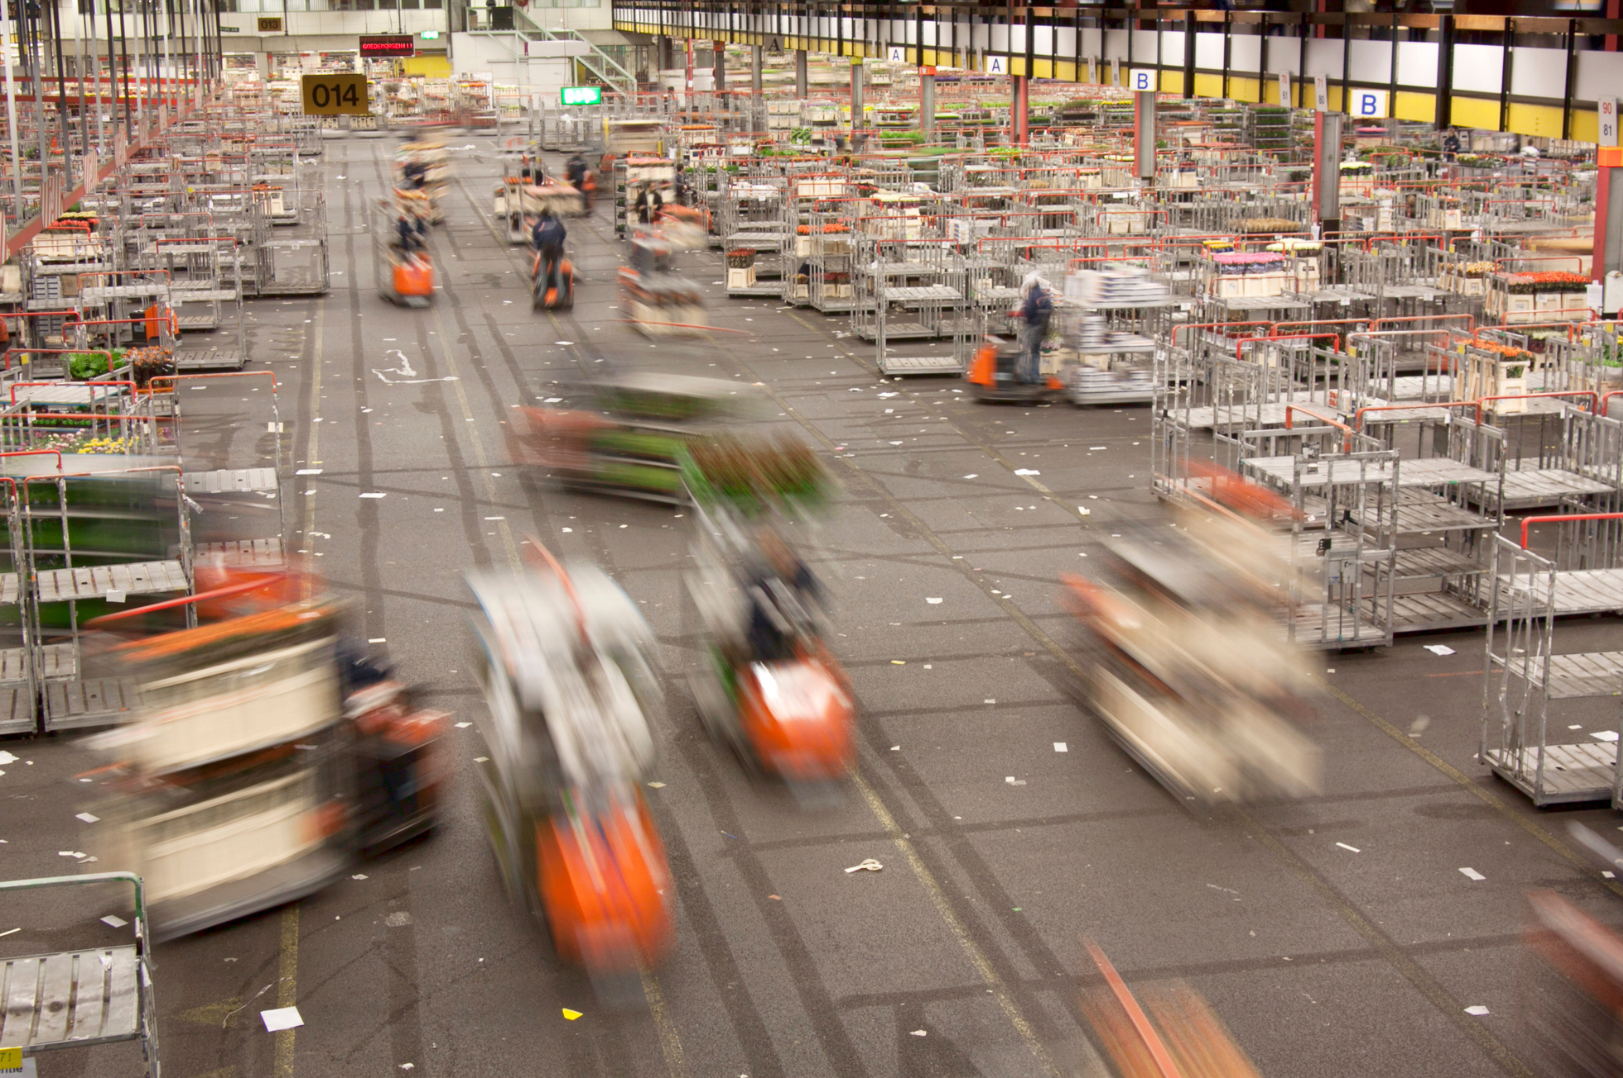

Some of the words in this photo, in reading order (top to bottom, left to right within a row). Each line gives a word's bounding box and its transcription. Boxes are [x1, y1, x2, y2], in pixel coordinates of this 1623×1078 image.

[260, 19, 279, 30] 013
[768, 37, 780, 51] A
[892, 49, 900, 61] A
[991, 58, 1001, 72] A
[1137, 72, 1149, 90] B
[312, 83, 360, 108] 014
[1361, 94, 1377, 115] B
[1602, 101, 1612, 115] 90
[1603, 123, 1612, 137] 81
